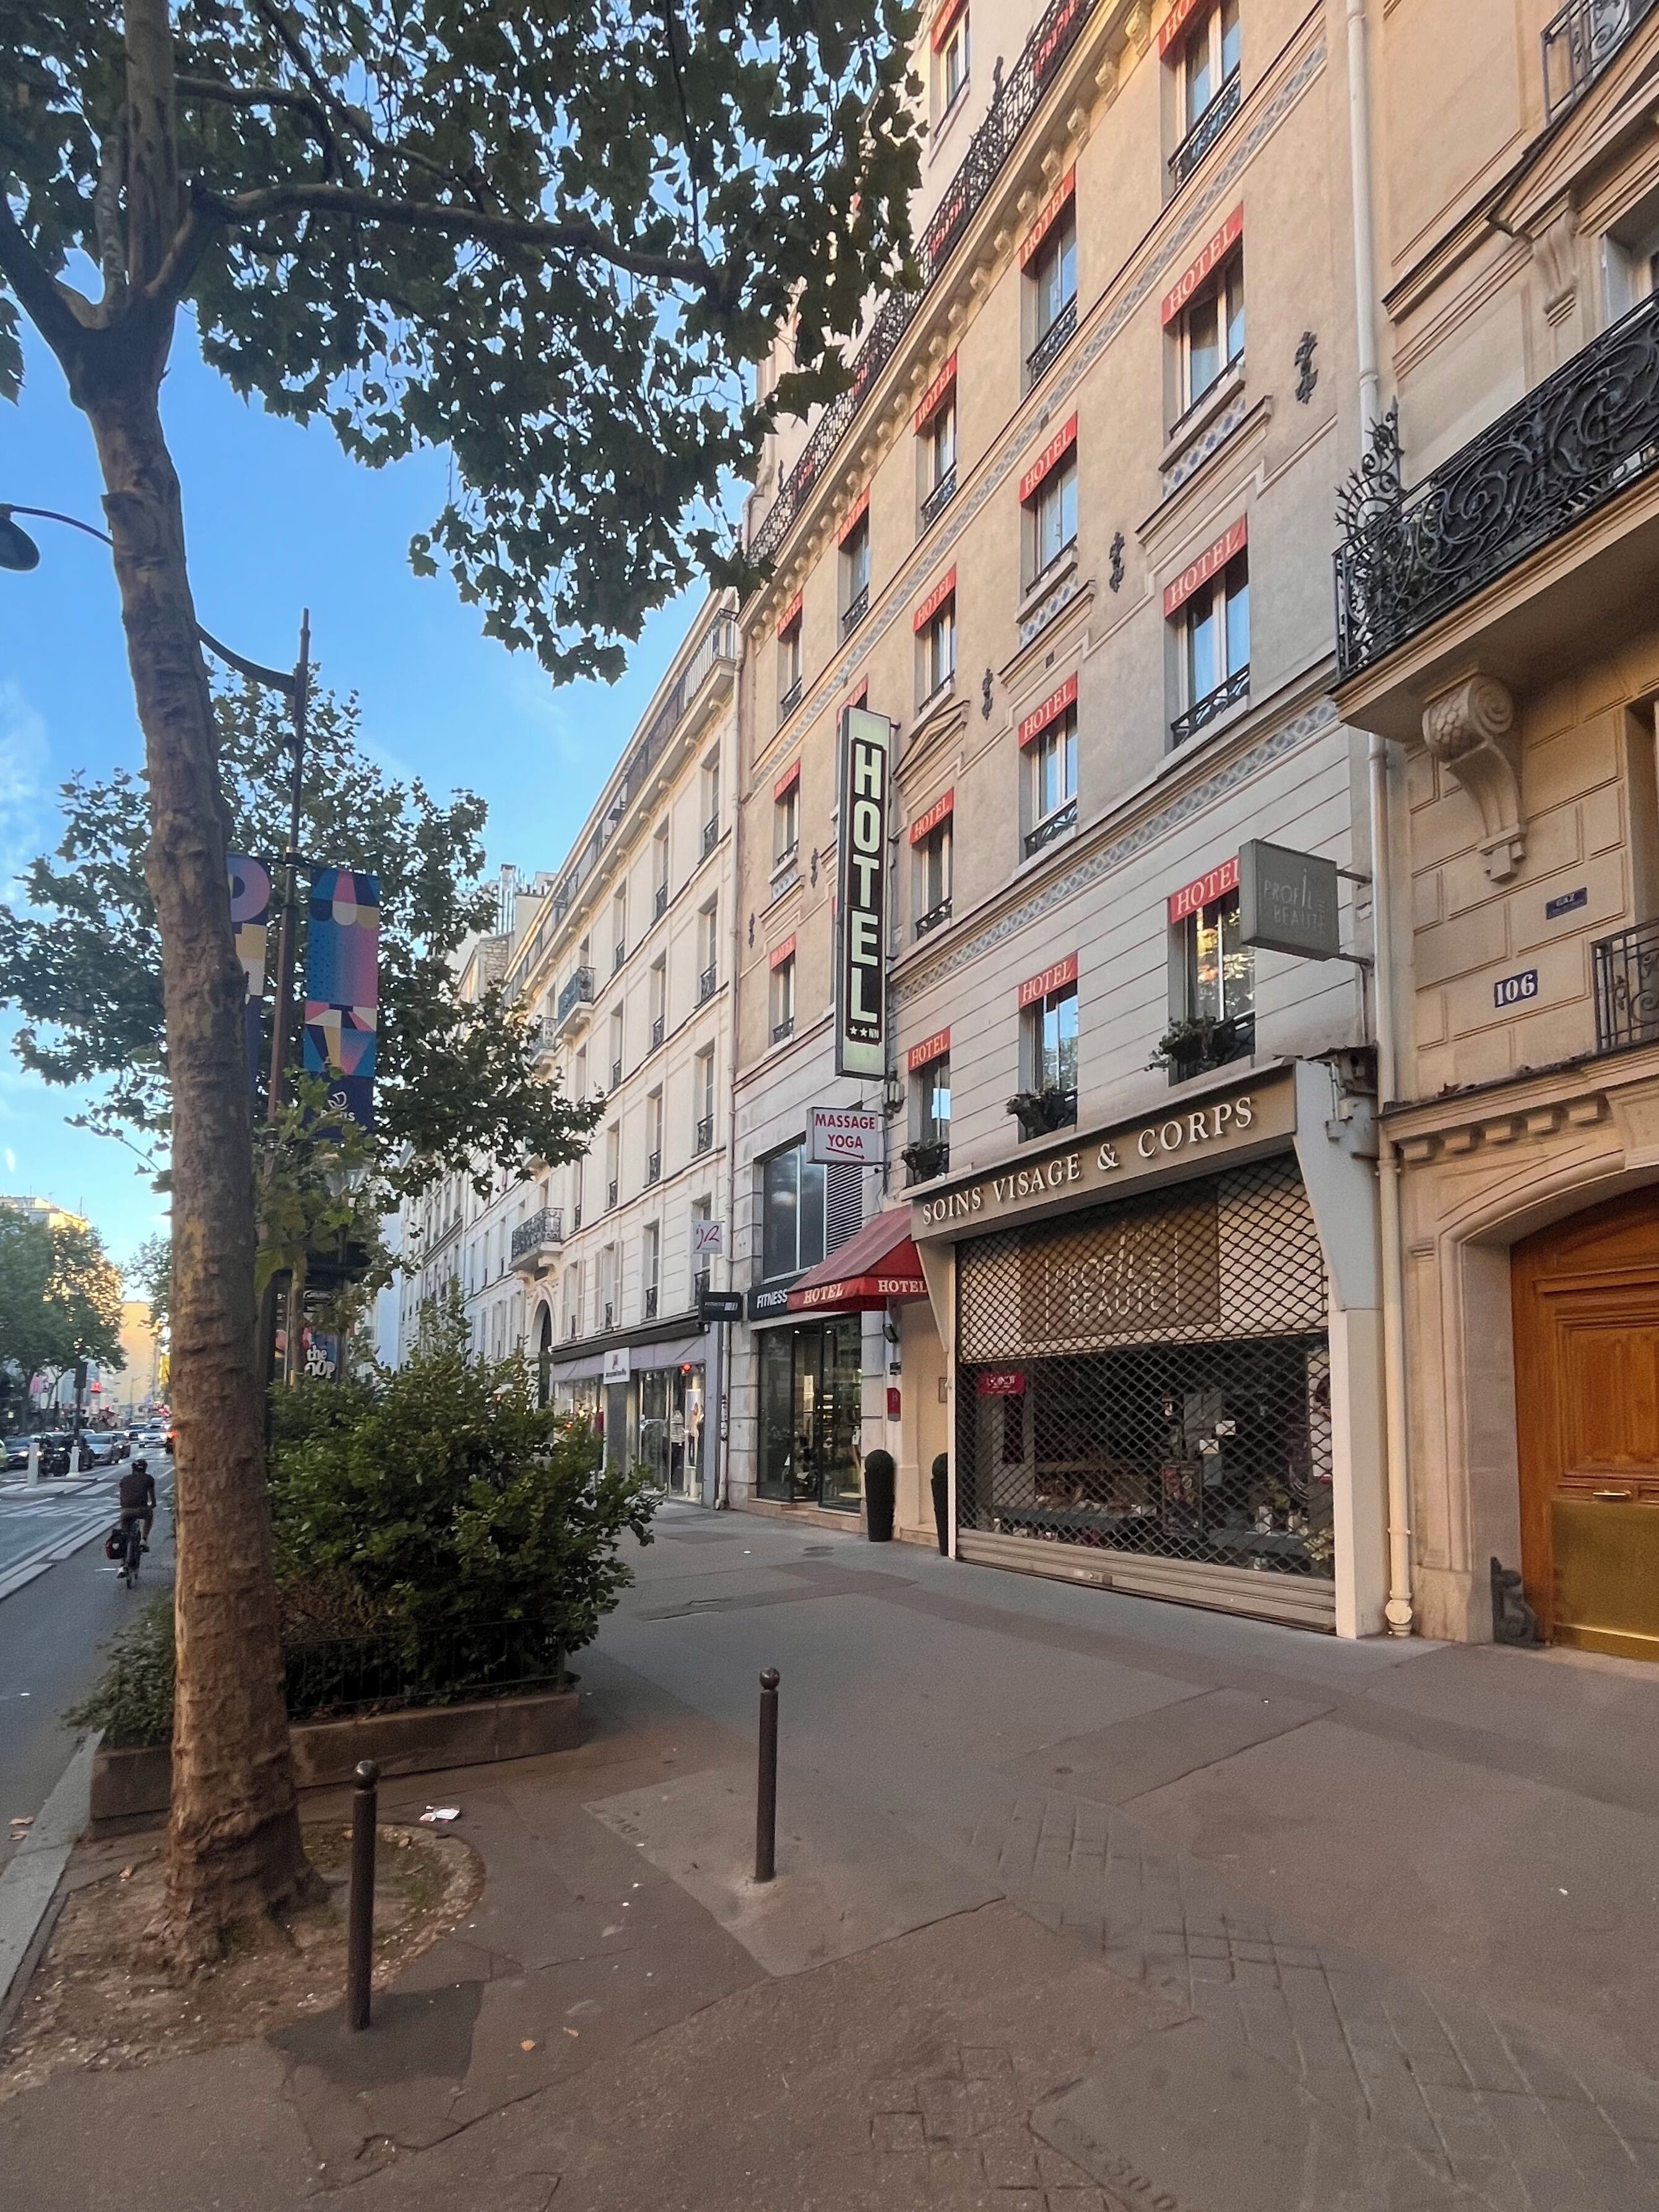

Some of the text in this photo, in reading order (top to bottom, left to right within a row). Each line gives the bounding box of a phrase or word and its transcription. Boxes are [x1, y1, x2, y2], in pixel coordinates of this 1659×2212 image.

[1023, 184, 1070, 260] HOTEL
[1169, 223, 1235, 316] HOTEL
[1024, 426, 1071, 495] HOTEL
[1171, 531, 1238, 607] HOTEL
[917, 576, 953, 628] HOTEL
[1023, 684, 1072, 740] HOTEL
[914, 797, 950, 839] HOTEL
[849, 743, 882, 1023] HOTEL
[1022, 961, 1072, 1003] HOTEL
[1497, 974, 1535, 1006] 106
[911, 1034, 948, 1068] HOTEL
[815, 1113, 875, 1130] MASSAGE
[828, 1134, 864, 1149] YOGA
[922, 1097, 1252, 1225] SOINS VISAGE & CORPS
[756, 1288, 788, 1309] FITNESS
[803, 1283, 844, 1304] HOTEL
[878, 1280, 927, 1293] HOTEL
[306, 1345, 327, 1361] the
